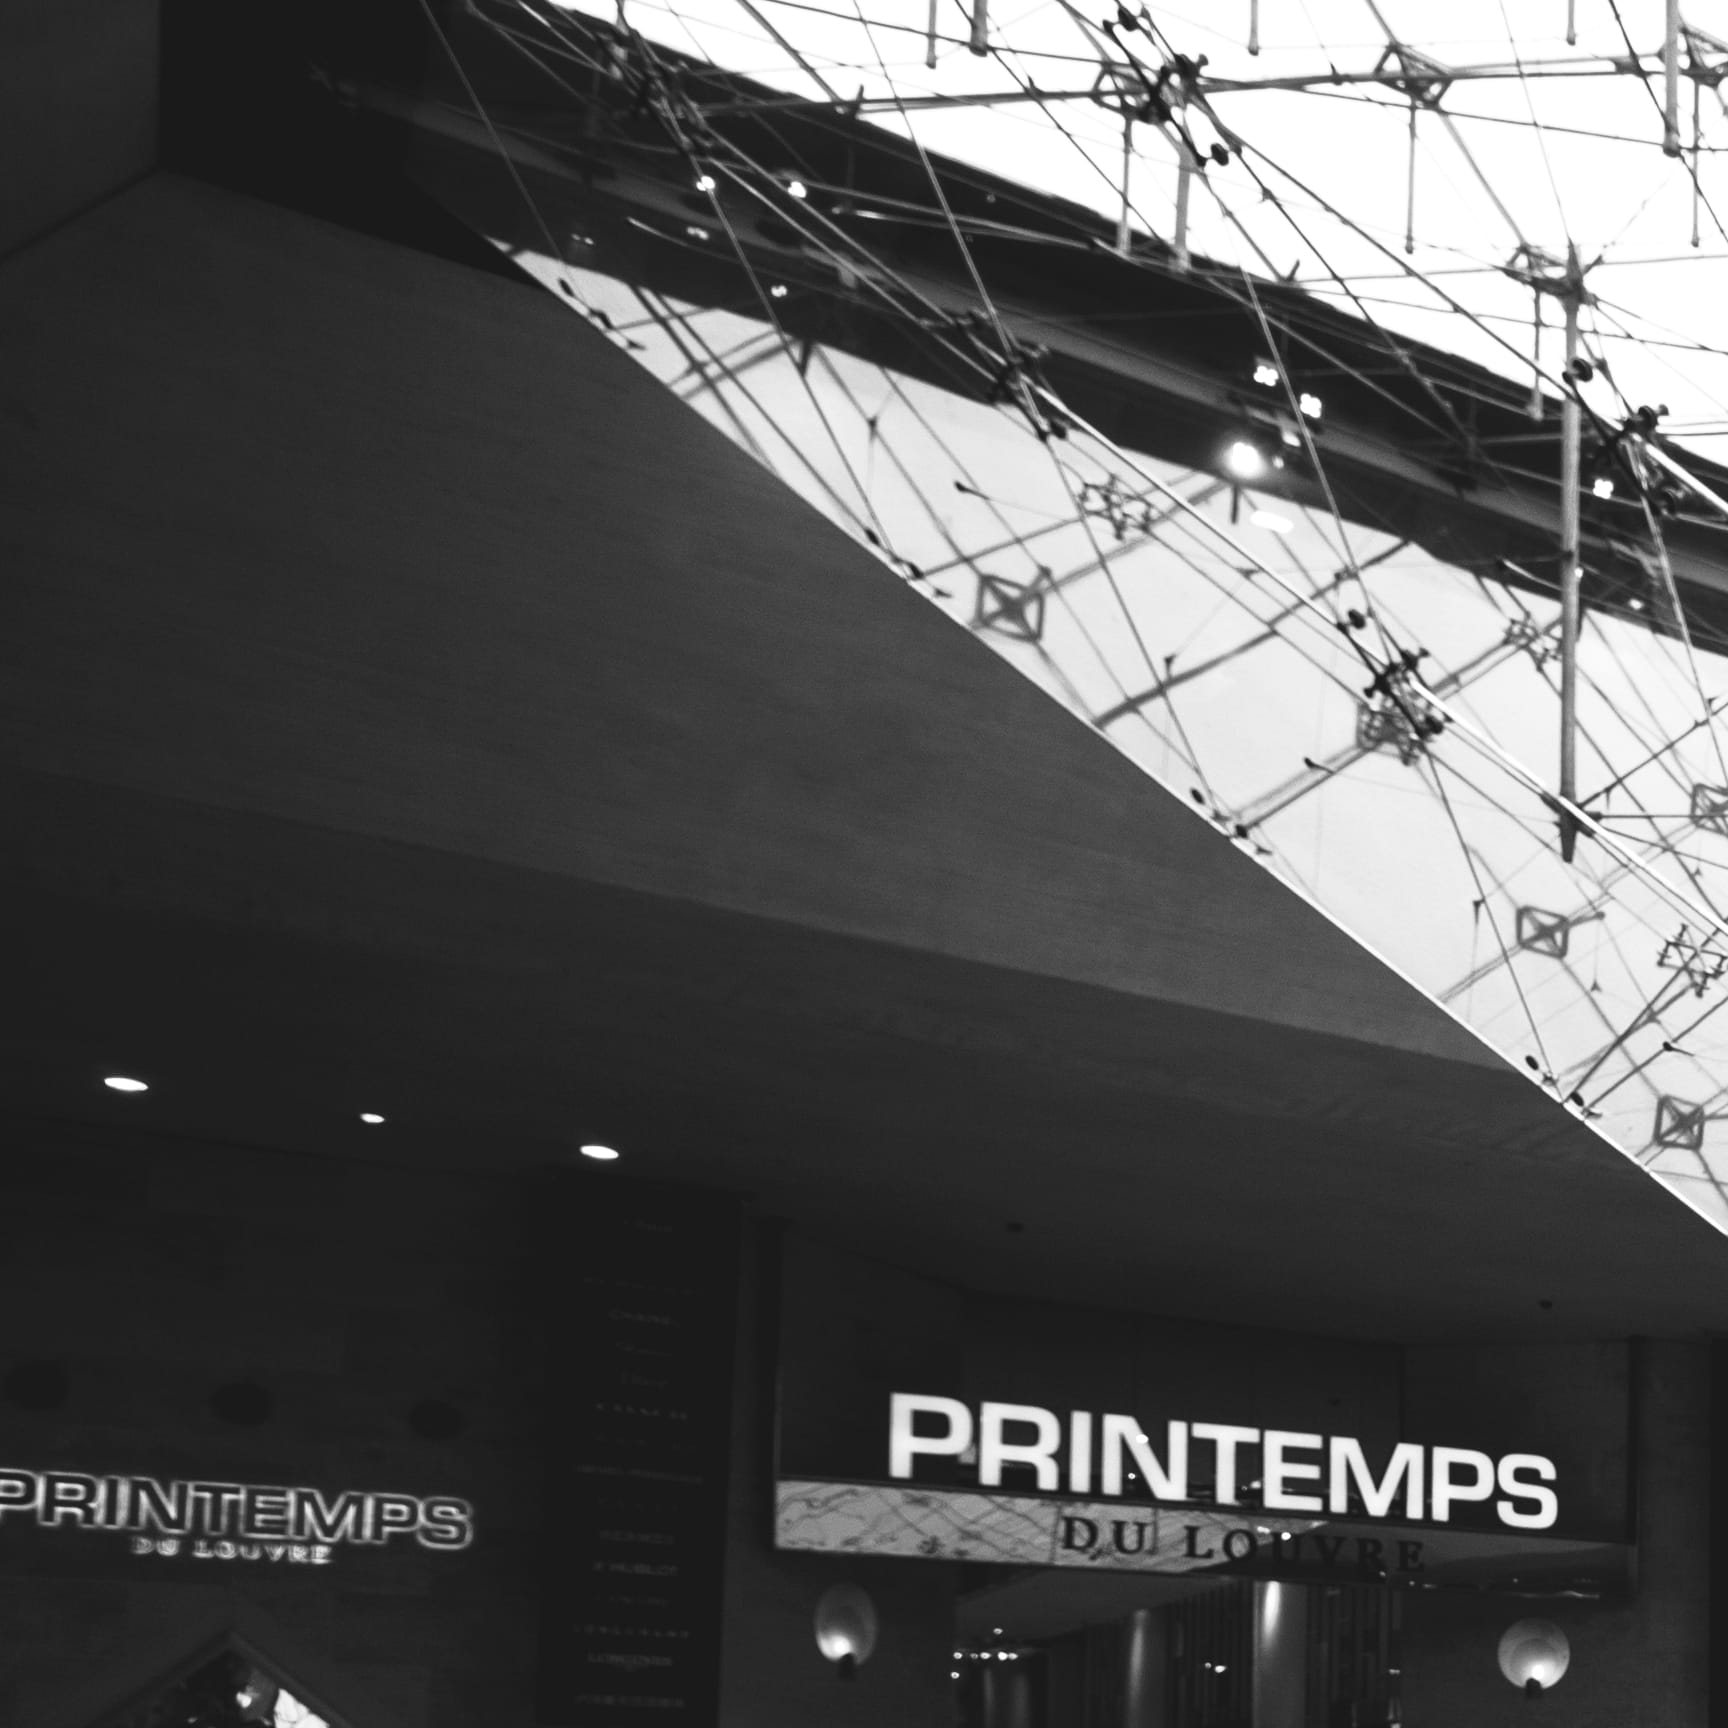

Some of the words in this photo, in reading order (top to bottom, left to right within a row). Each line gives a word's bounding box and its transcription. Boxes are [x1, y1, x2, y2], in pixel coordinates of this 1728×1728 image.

[888, 1391, 1559, 1531] PRINTEMPS
[131, 1536, 182, 1557] DU
[191, 1539, 334, 1566] LOUVRE
[1060, 1514, 1149, 1556] DU
[1183, 1525, 1426, 1574] LOUVRE
